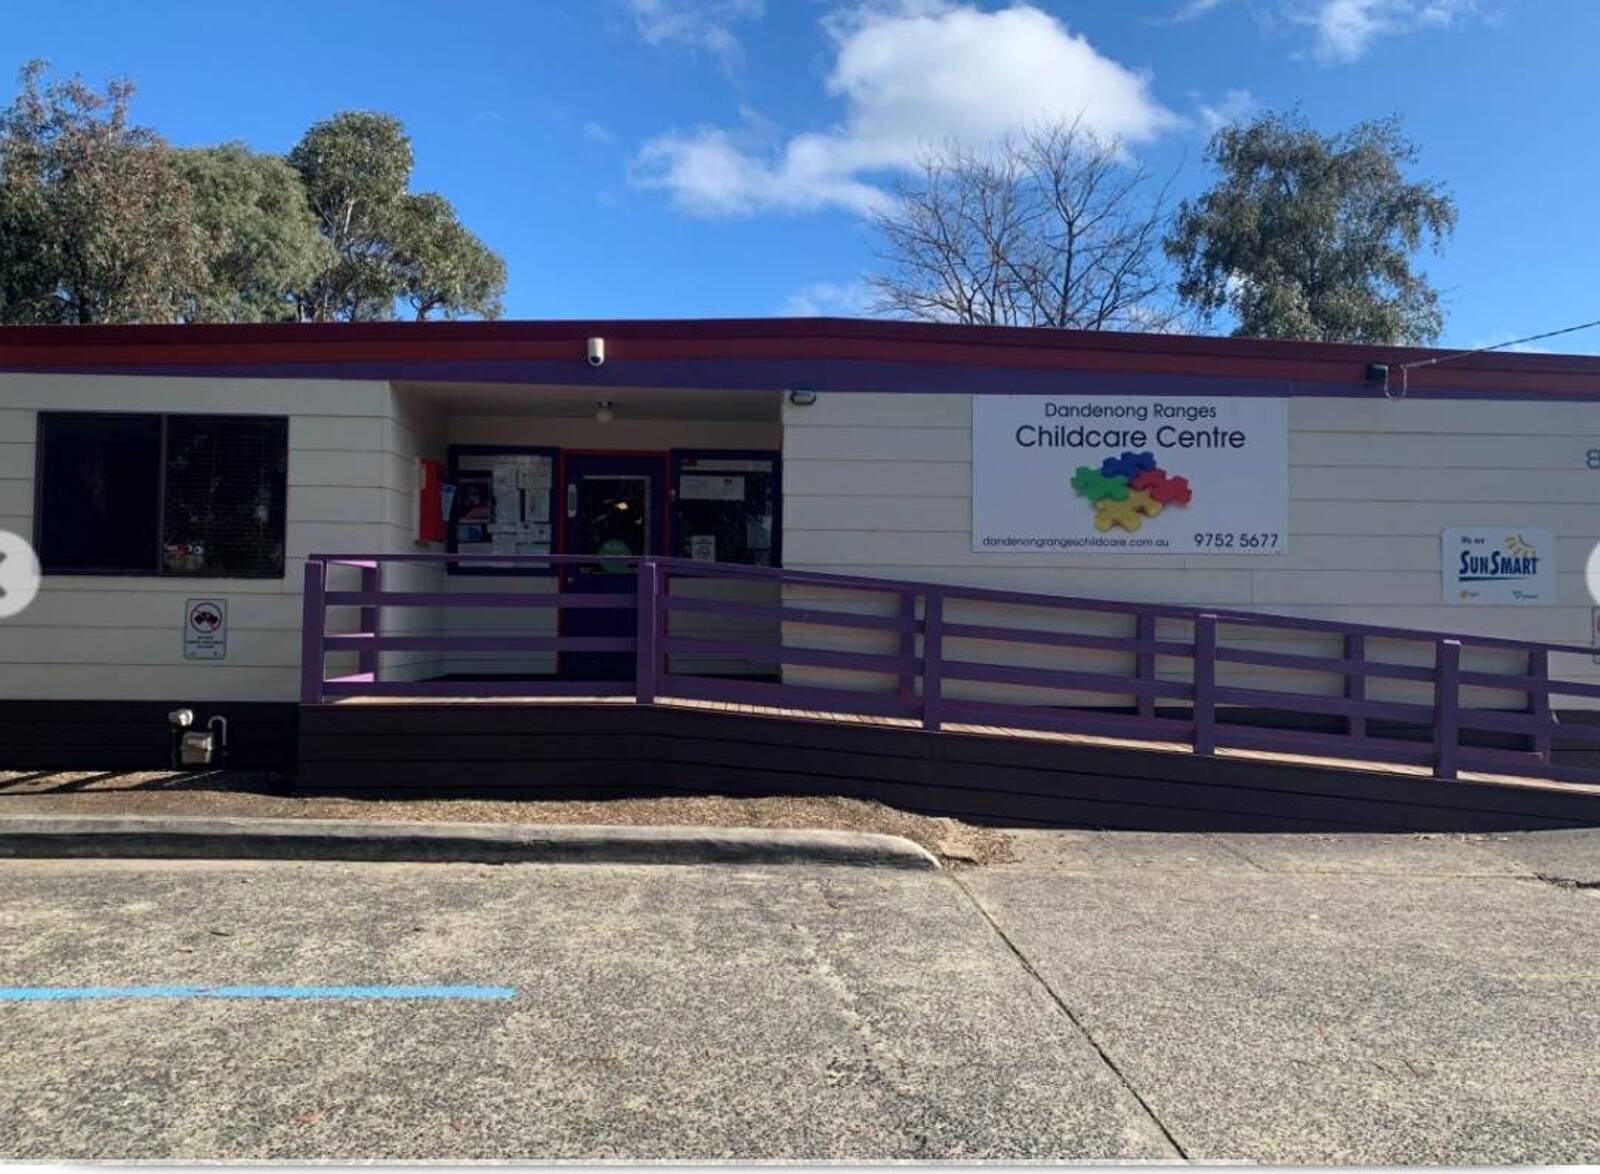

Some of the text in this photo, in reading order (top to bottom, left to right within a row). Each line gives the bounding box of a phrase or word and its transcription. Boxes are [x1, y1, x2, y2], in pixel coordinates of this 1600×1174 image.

[1045, 402, 1217, 421] Dandenong Ranges
[1015, 425, 1247, 448] Childcare Centre
[982, 536, 1170, 550] dandenongrangeschildcare.com.au
[1194, 533, 1279, 548] 9752 5677
